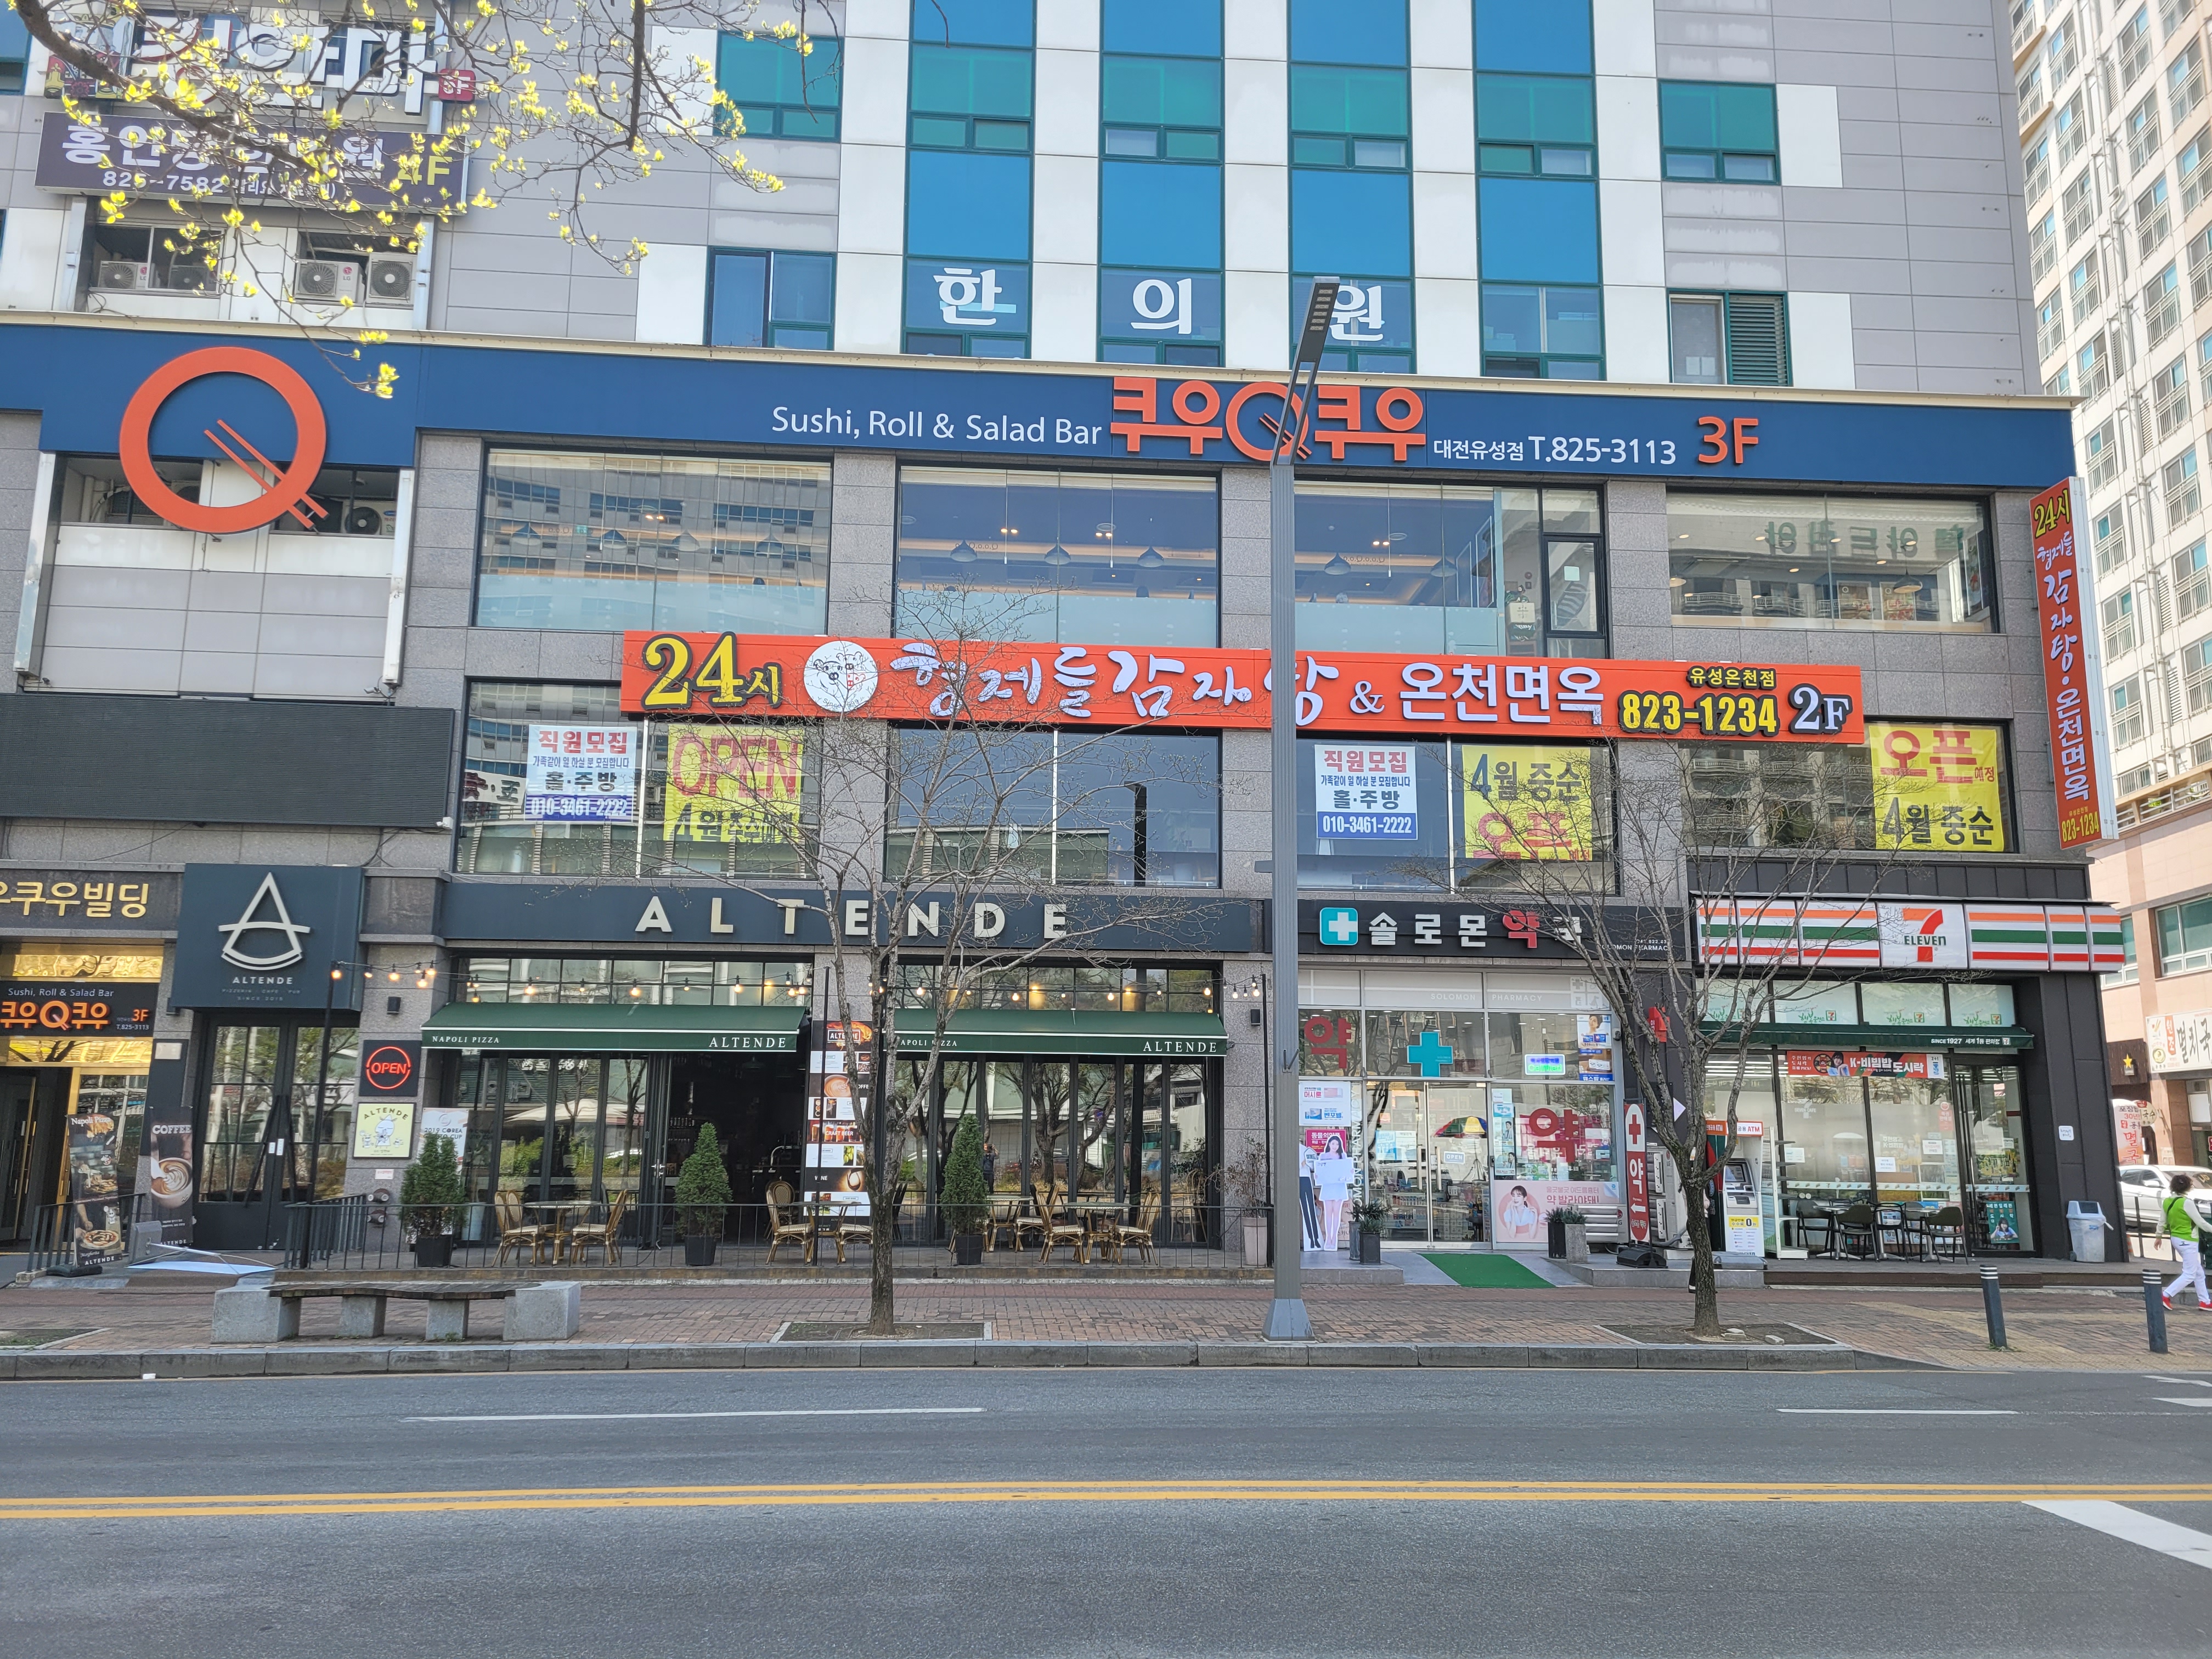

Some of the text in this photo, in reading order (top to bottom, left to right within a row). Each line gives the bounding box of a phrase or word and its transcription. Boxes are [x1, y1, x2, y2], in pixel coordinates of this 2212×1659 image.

[772, 407, 1102, 444] Sushi, Roll & Salad Bar
[1434, 436, 1676, 465] 대전유성점 T.825-3113
[1698, 416, 1758, 465] 3F
[2034, 489, 2070, 539] 24시
[2036, 531, 2073, 571] 형제들
[642, 631, 782, 709] 24시
[1688, 666, 1776, 689] 유성온천점
[1350, 681, 1384, 714] &
[1400, 662, 1603, 725] 온천면옥
[1621, 692, 1778, 735] 823-1234
[1791, 686, 1850, 732] 2F
[539, 731, 627, 754] 직원모집
[533, 756, 561, 768] 가족같이
[563, 757, 569, 767] 일
[596, 757, 629, 768] 모집합니다
[673, 733, 798, 799] OPEN
[1324, 751, 1407, 773] 직원모집
[1880, 730, 1995, 784] 오픈 예정
[1321, 775, 1410, 787] 가족같이 일 하실 분 모집합니다
[1471, 753, 1582, 802] 4월 중순
[531, 798, 627, 816] 010-3461-2222
[1323, 815, 1412, 833] 010-3461-2222
[1882, 797, 1994, 845] 4월 중순
[2062, 811, 2100, 843] 823-1234
[635, 896, 1066, 939] ALTENDE
[8, 988, 35, 997] Sushi,
[232, 977, 293, 985] ALTENDE
[132, 1009, 149, 1022] 3F
[472, 1036, 500, 1044] PIZZA
[709, 1036, 786, 1048] ALTENDE
[1143, 1040, 1218, 1053] ALTENDE
[1304, 1017, 1352, 1069] 약
[2166, 1019, 2175, 1051] 원조
[370, 1062, 407, 1074] OPEN
[1850, 1057, 1925, 1073] K-비빔밥 도시락
[71, 1116, 93, 1127] Napoli
[364, 1107, 409, 1120] ALTENDE
[153, 1125, 192, 1134] COFFEE
[1529, 1108, 1579, 1163] 약
[1629, 1158, 1645, 1195] 약
[1547, 1195, 1556, 1205] 약
[84, 1256, 115, 1266] ALTENDE
